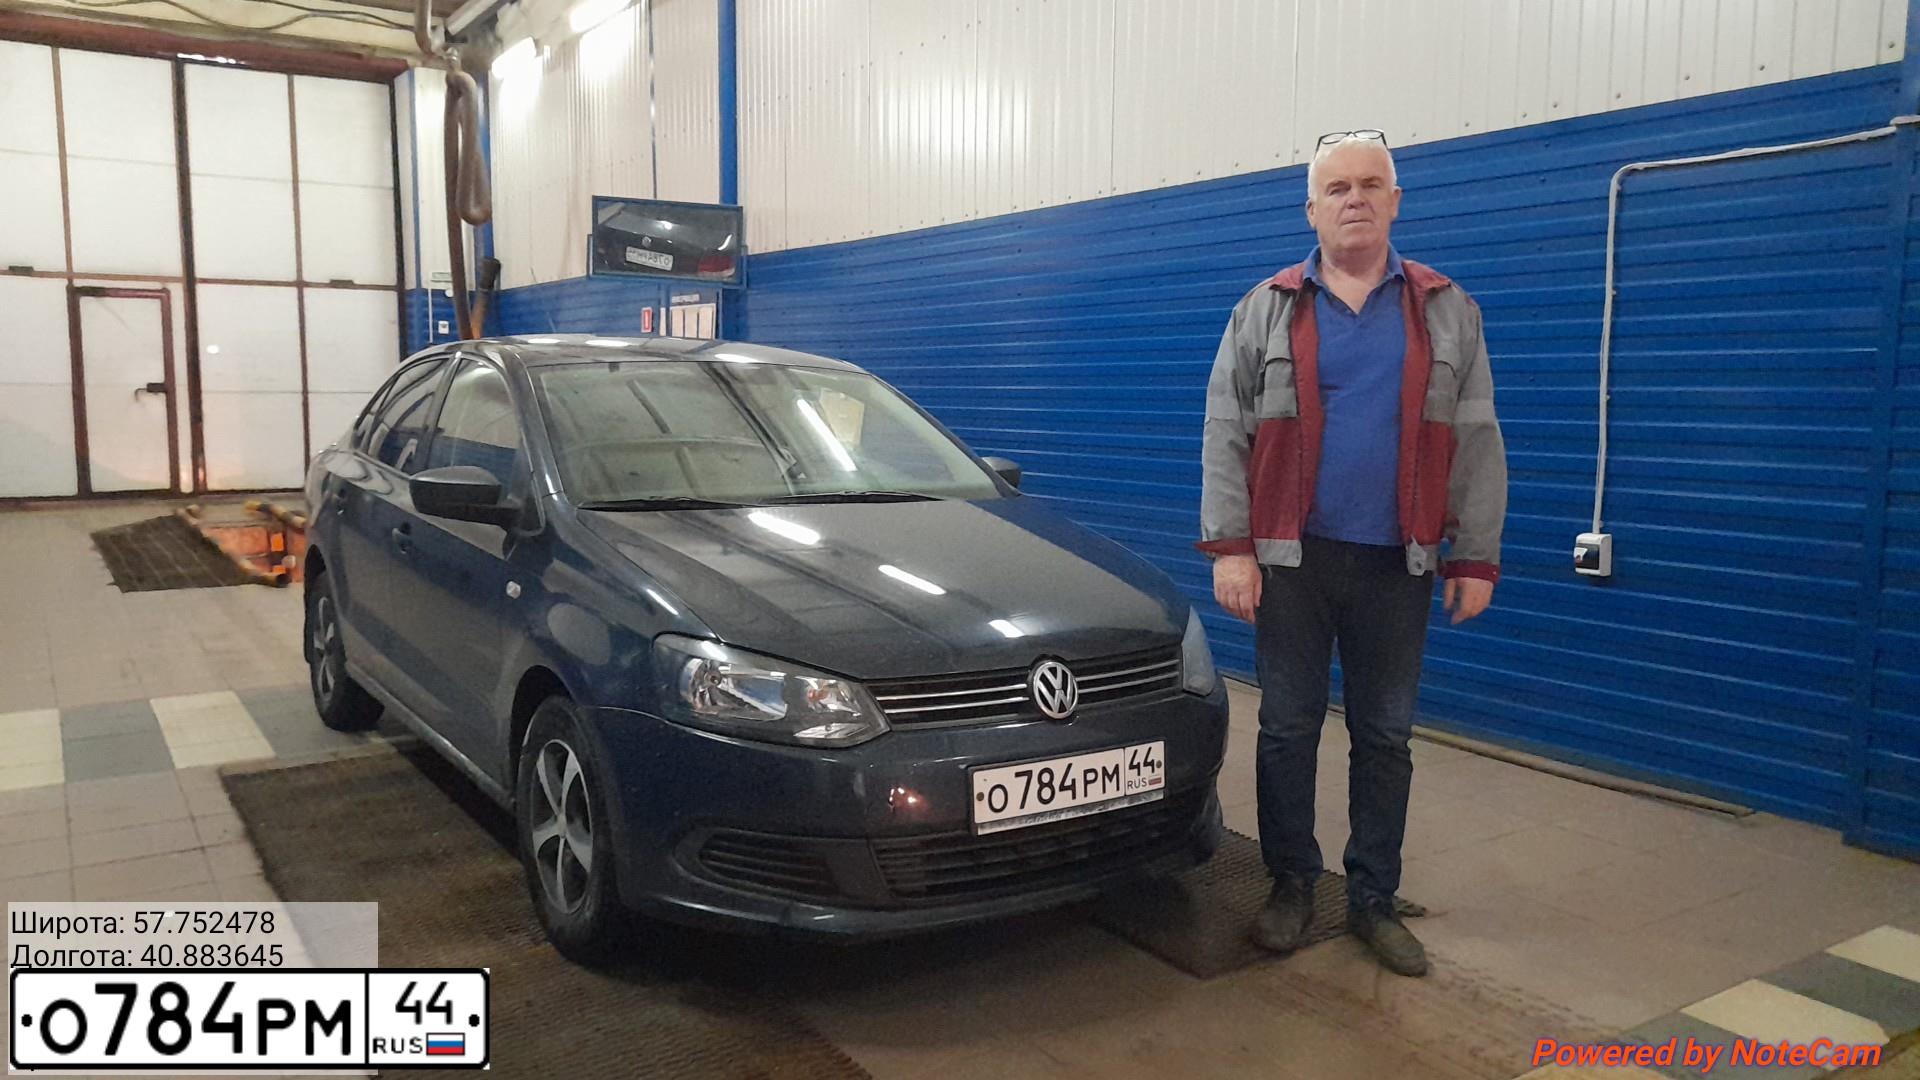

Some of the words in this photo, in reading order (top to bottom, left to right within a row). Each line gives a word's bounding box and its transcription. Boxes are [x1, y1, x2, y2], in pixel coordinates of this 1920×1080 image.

[988, 763, 1120, 813] О784РМ
[1128, 746, 1155, 776] 44
[1127, 777, 1148, 789] RUS
